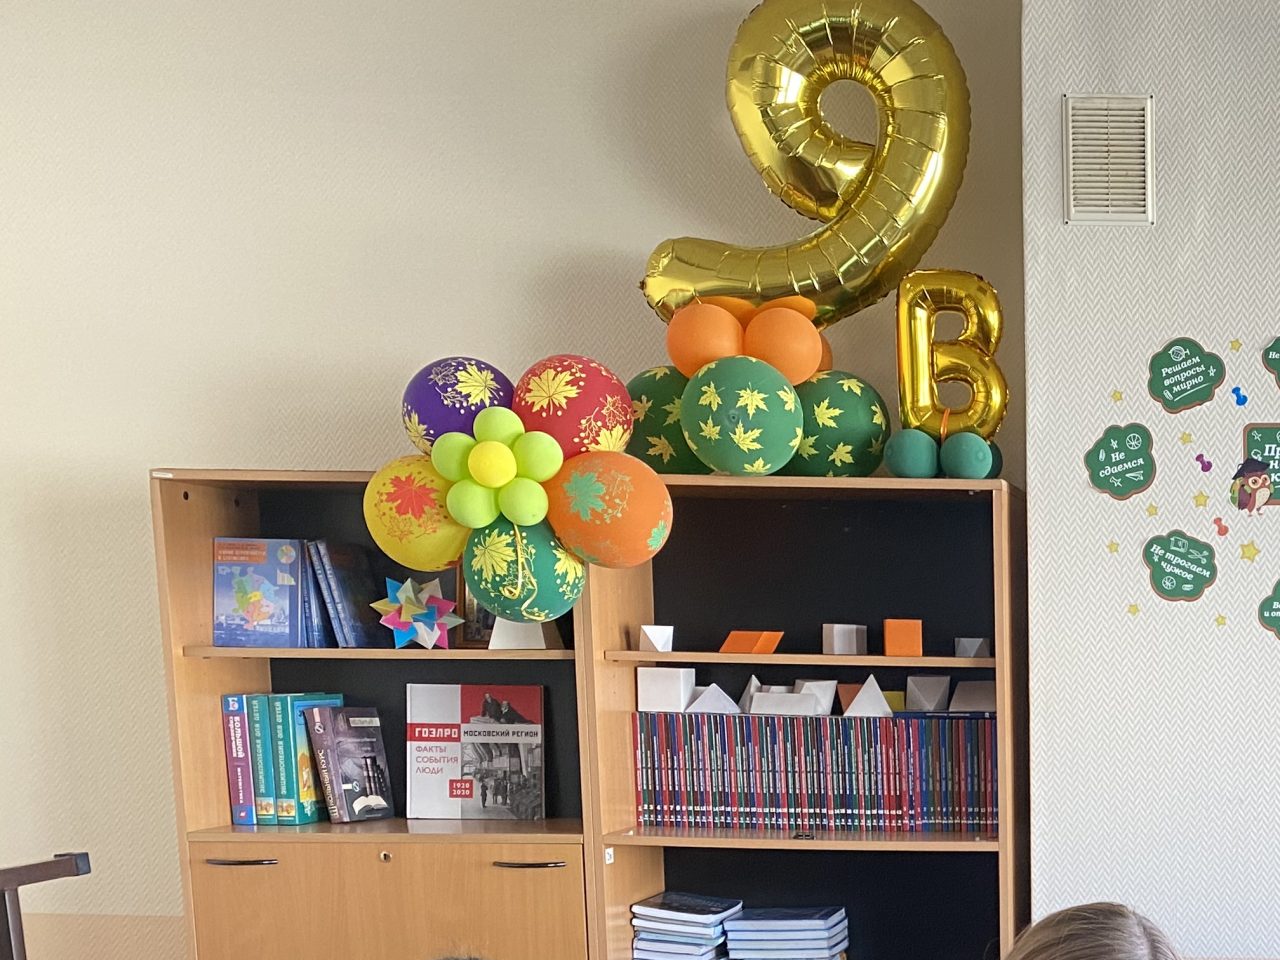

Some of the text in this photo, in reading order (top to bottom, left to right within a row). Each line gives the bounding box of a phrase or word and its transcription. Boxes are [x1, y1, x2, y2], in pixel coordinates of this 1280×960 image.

[639, 0, 972, 330] 9
[1269, 351, 1280, 359] Не
[1161, 356, 1201, 377] Решаем
[1163, 364, 1206, 386] вопросы
[1172, 375, 1204, 393] мирно
[1110, 451, 1126, 463] Не
[1099, 457, 1145, 478] сдаемся
[1150, 543, 1211, 578] Не трогаем
[1160, 560, 1194, 580] чужое
[415, 727, 459, 738] ГОЭЛРО
[463, 728, 539, 737] МОСКОВСКИЙ РЕГИОН
[415, 745, 447, 753] ФАКТЫ
[415, 756, 458, 764] СОБЫТИЯ
[415, 767, 443, 775] ЛЮДИ
